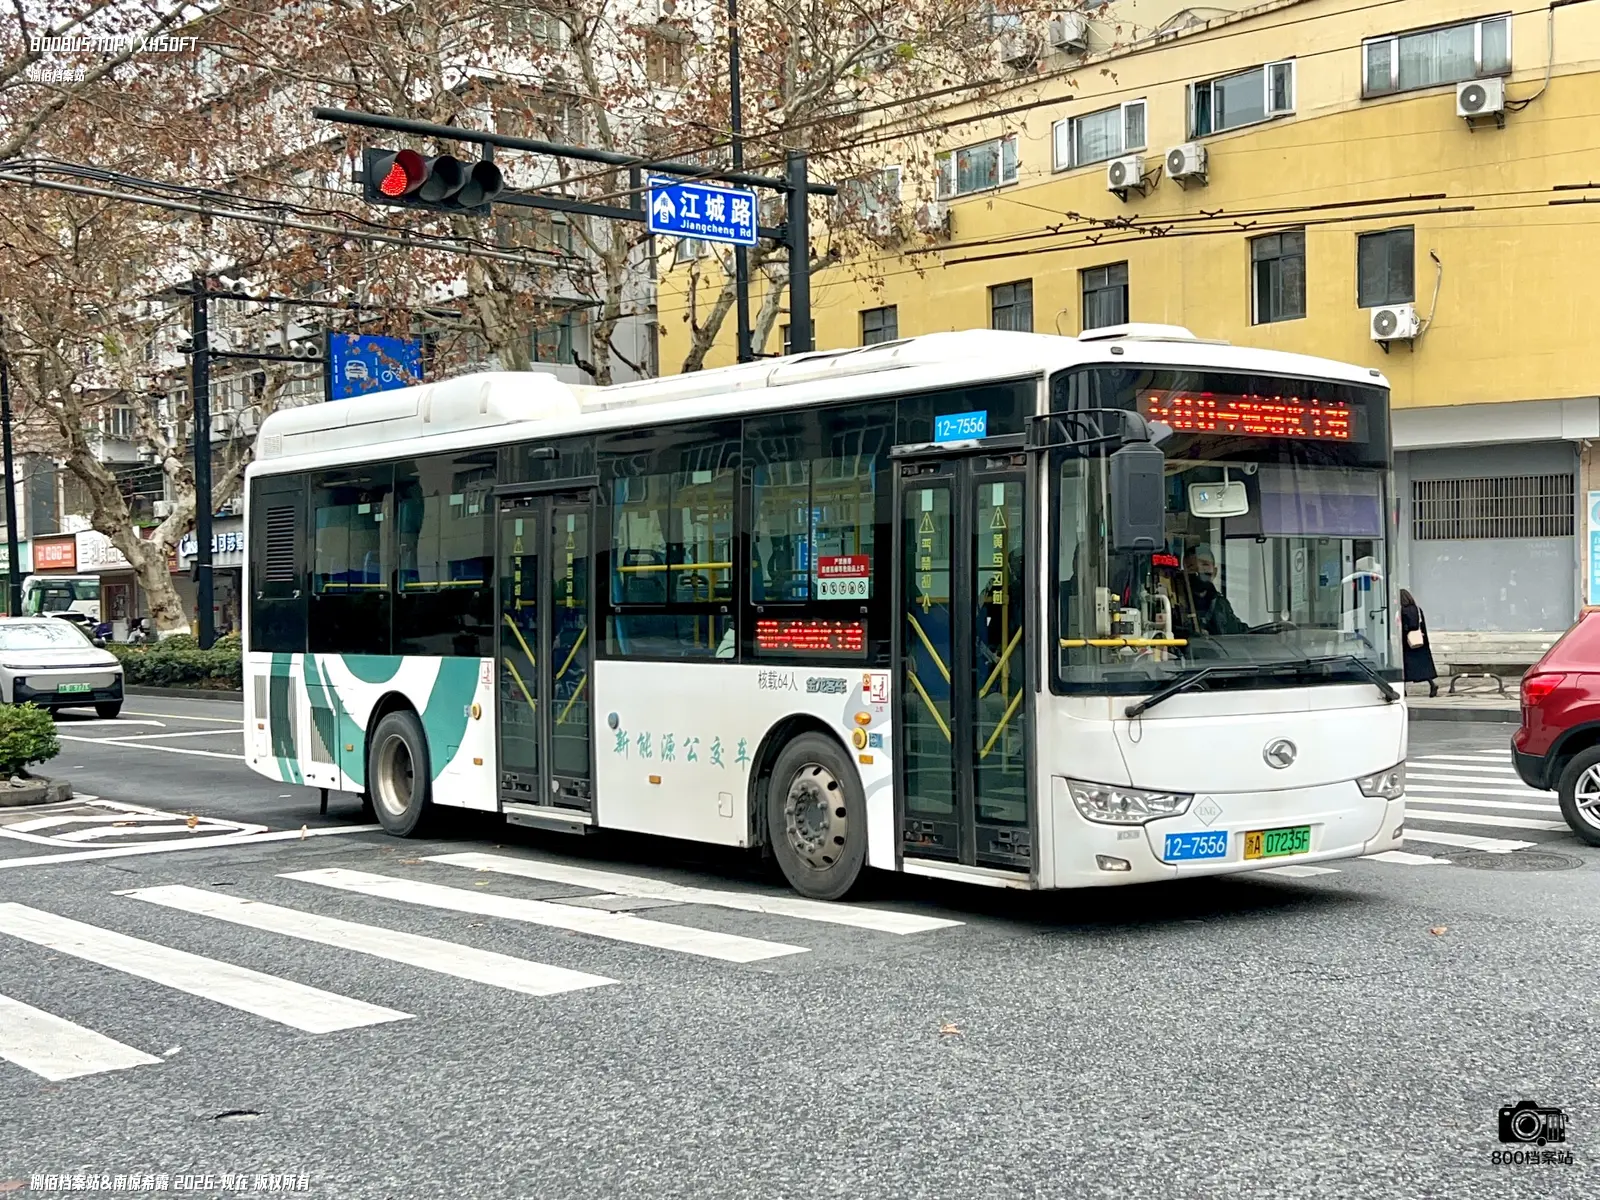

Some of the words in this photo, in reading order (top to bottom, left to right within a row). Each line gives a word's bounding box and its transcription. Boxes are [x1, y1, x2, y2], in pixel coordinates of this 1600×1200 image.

[662, 211, 668, 220] S
[679, 190, 751, 227] 江城路
[680, 219, 735, 237] Jiangcheng
[740, 228, 751, 237] Rd
[937, 416, 985, 437] 12-7556
[758, 670, 798, 691] 核载64人
[806, 677, 847, 694] 金龙客车
[613, 728, 751, 772] 新能源公交车
[1200, 806, 1216, 816] LNG
[1165, 835, 1226, 857] 12-7556
[1266, 830, 1309, 853] 07235F
